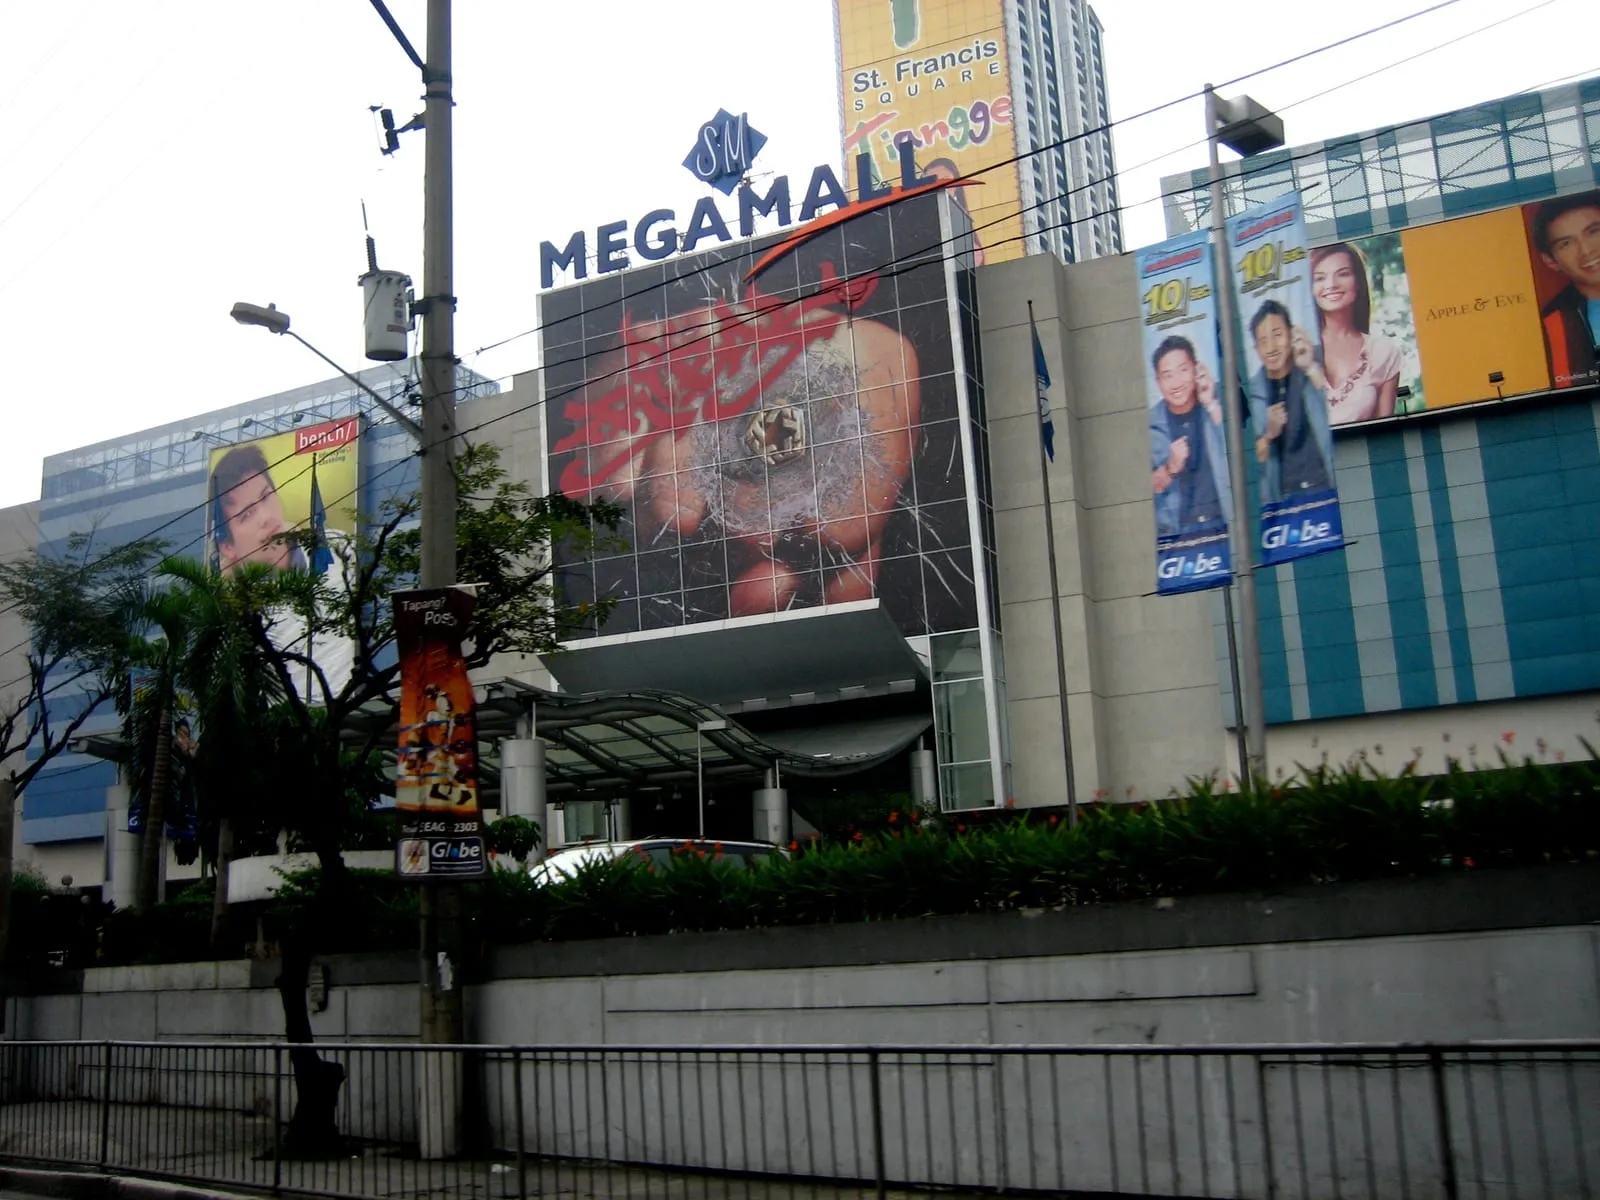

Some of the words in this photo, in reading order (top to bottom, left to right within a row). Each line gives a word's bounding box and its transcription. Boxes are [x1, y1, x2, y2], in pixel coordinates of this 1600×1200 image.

[853, 69, 888, 94] St.
[896, 40, 998, 82] Francis
[854, 62, 1000, 111] SQUARE
[696, 113, 751, 178] SM
[845, 97, 1012, 187] Tiangge
[540, 140, 937, 289] MEGAMALL
[1425, 304, 1471, 322] APPLE
[1495, 293, 1527, 309] EVE
[453, 821, 480, 833] 2303
